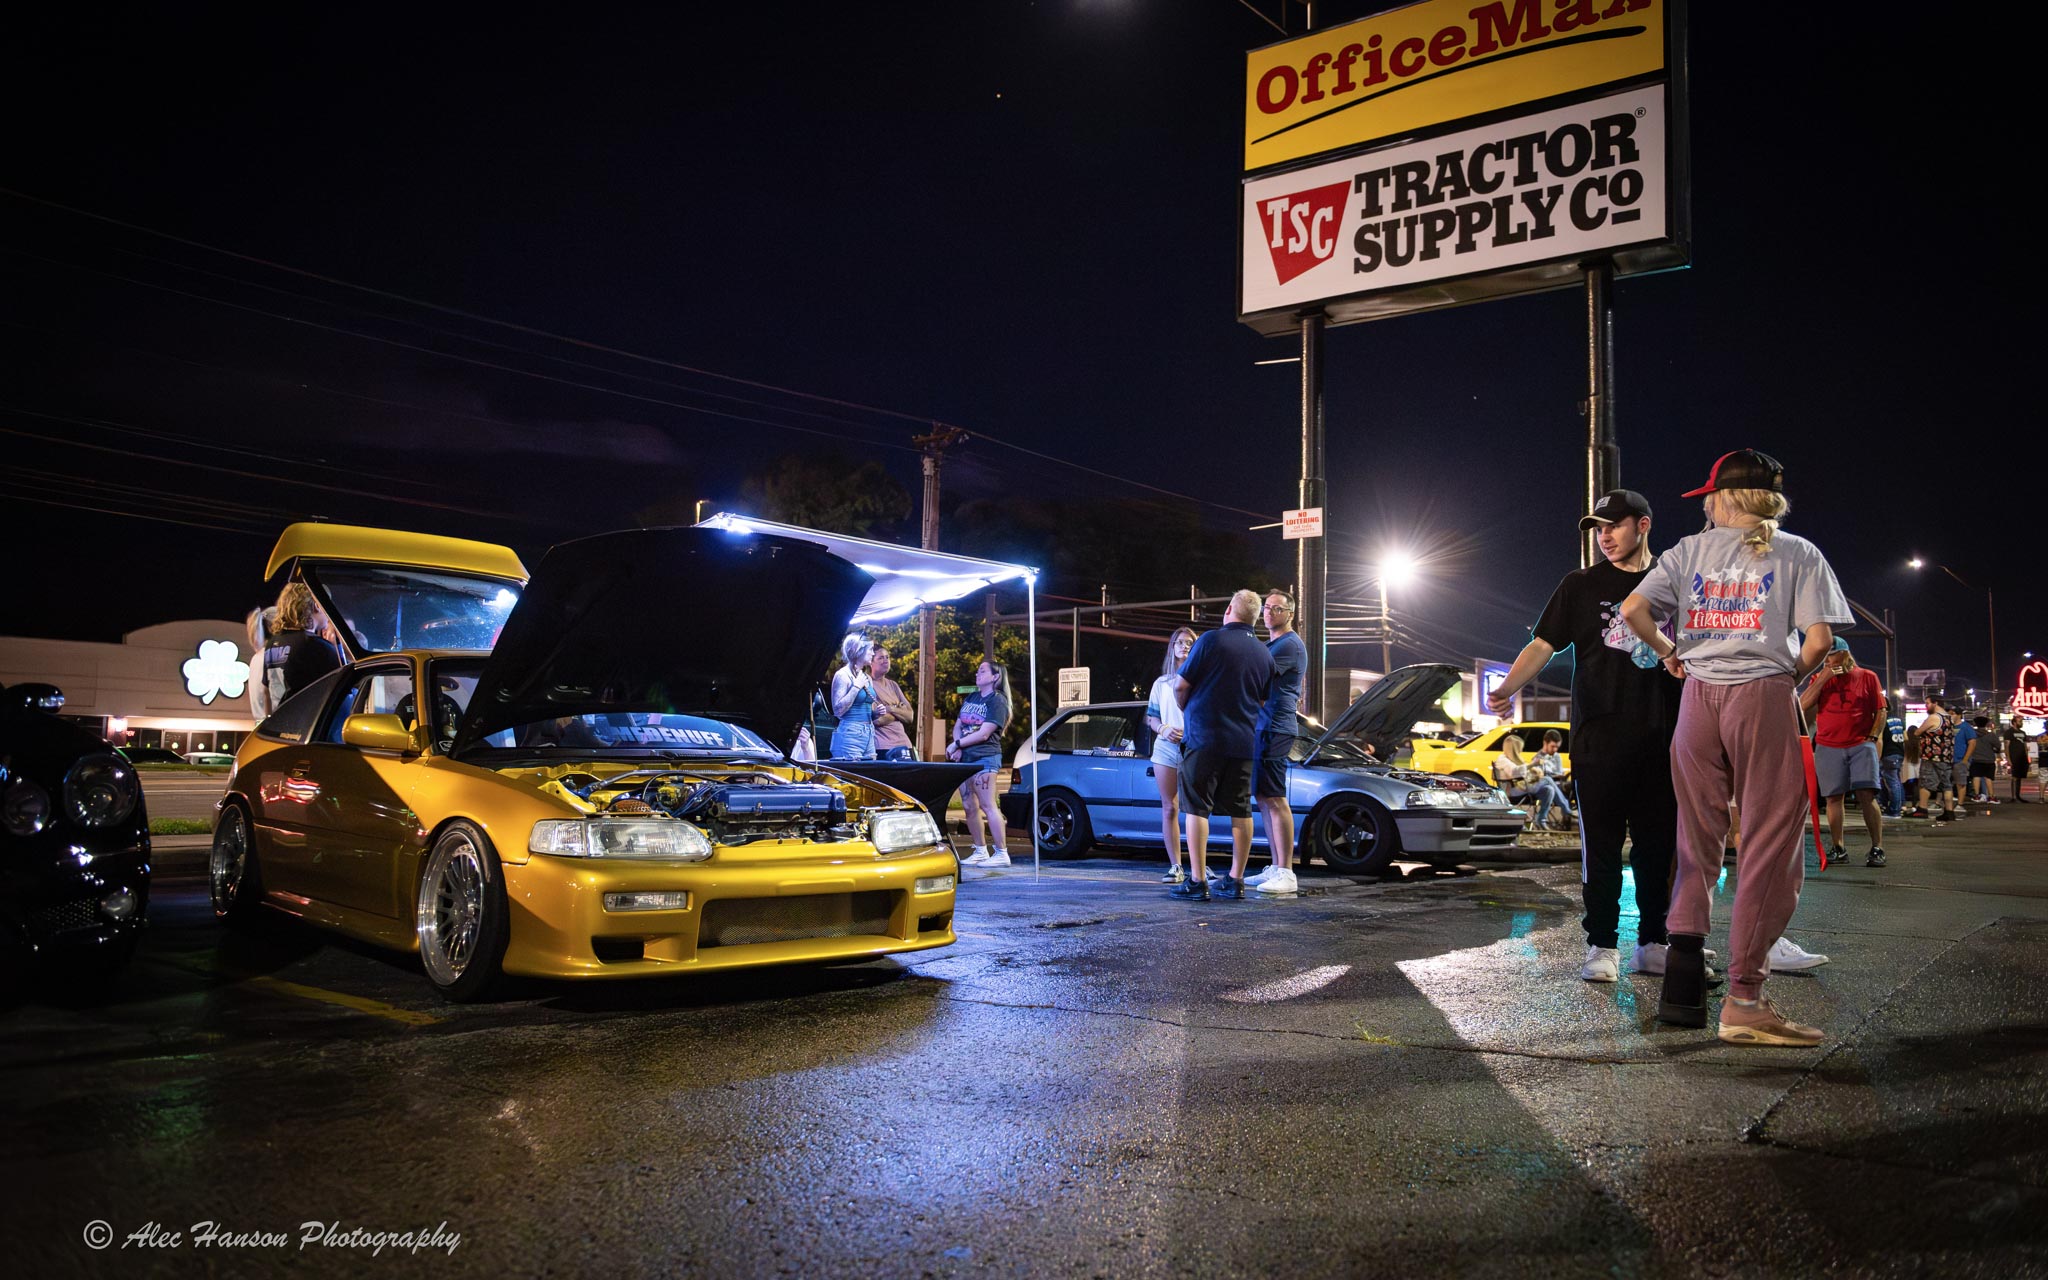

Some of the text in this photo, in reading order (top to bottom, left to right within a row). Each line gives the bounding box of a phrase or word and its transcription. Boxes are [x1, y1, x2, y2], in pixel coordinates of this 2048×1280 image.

[1354, 112, 1640, 219] TRACTOR
[1266, 197, 1334, 260] TSC
[1353, 186, 1564, 274] SUPPLY
[1286, 517, 1319, 525] LOITERING
[1609, 629, 1628, 643] ALL
